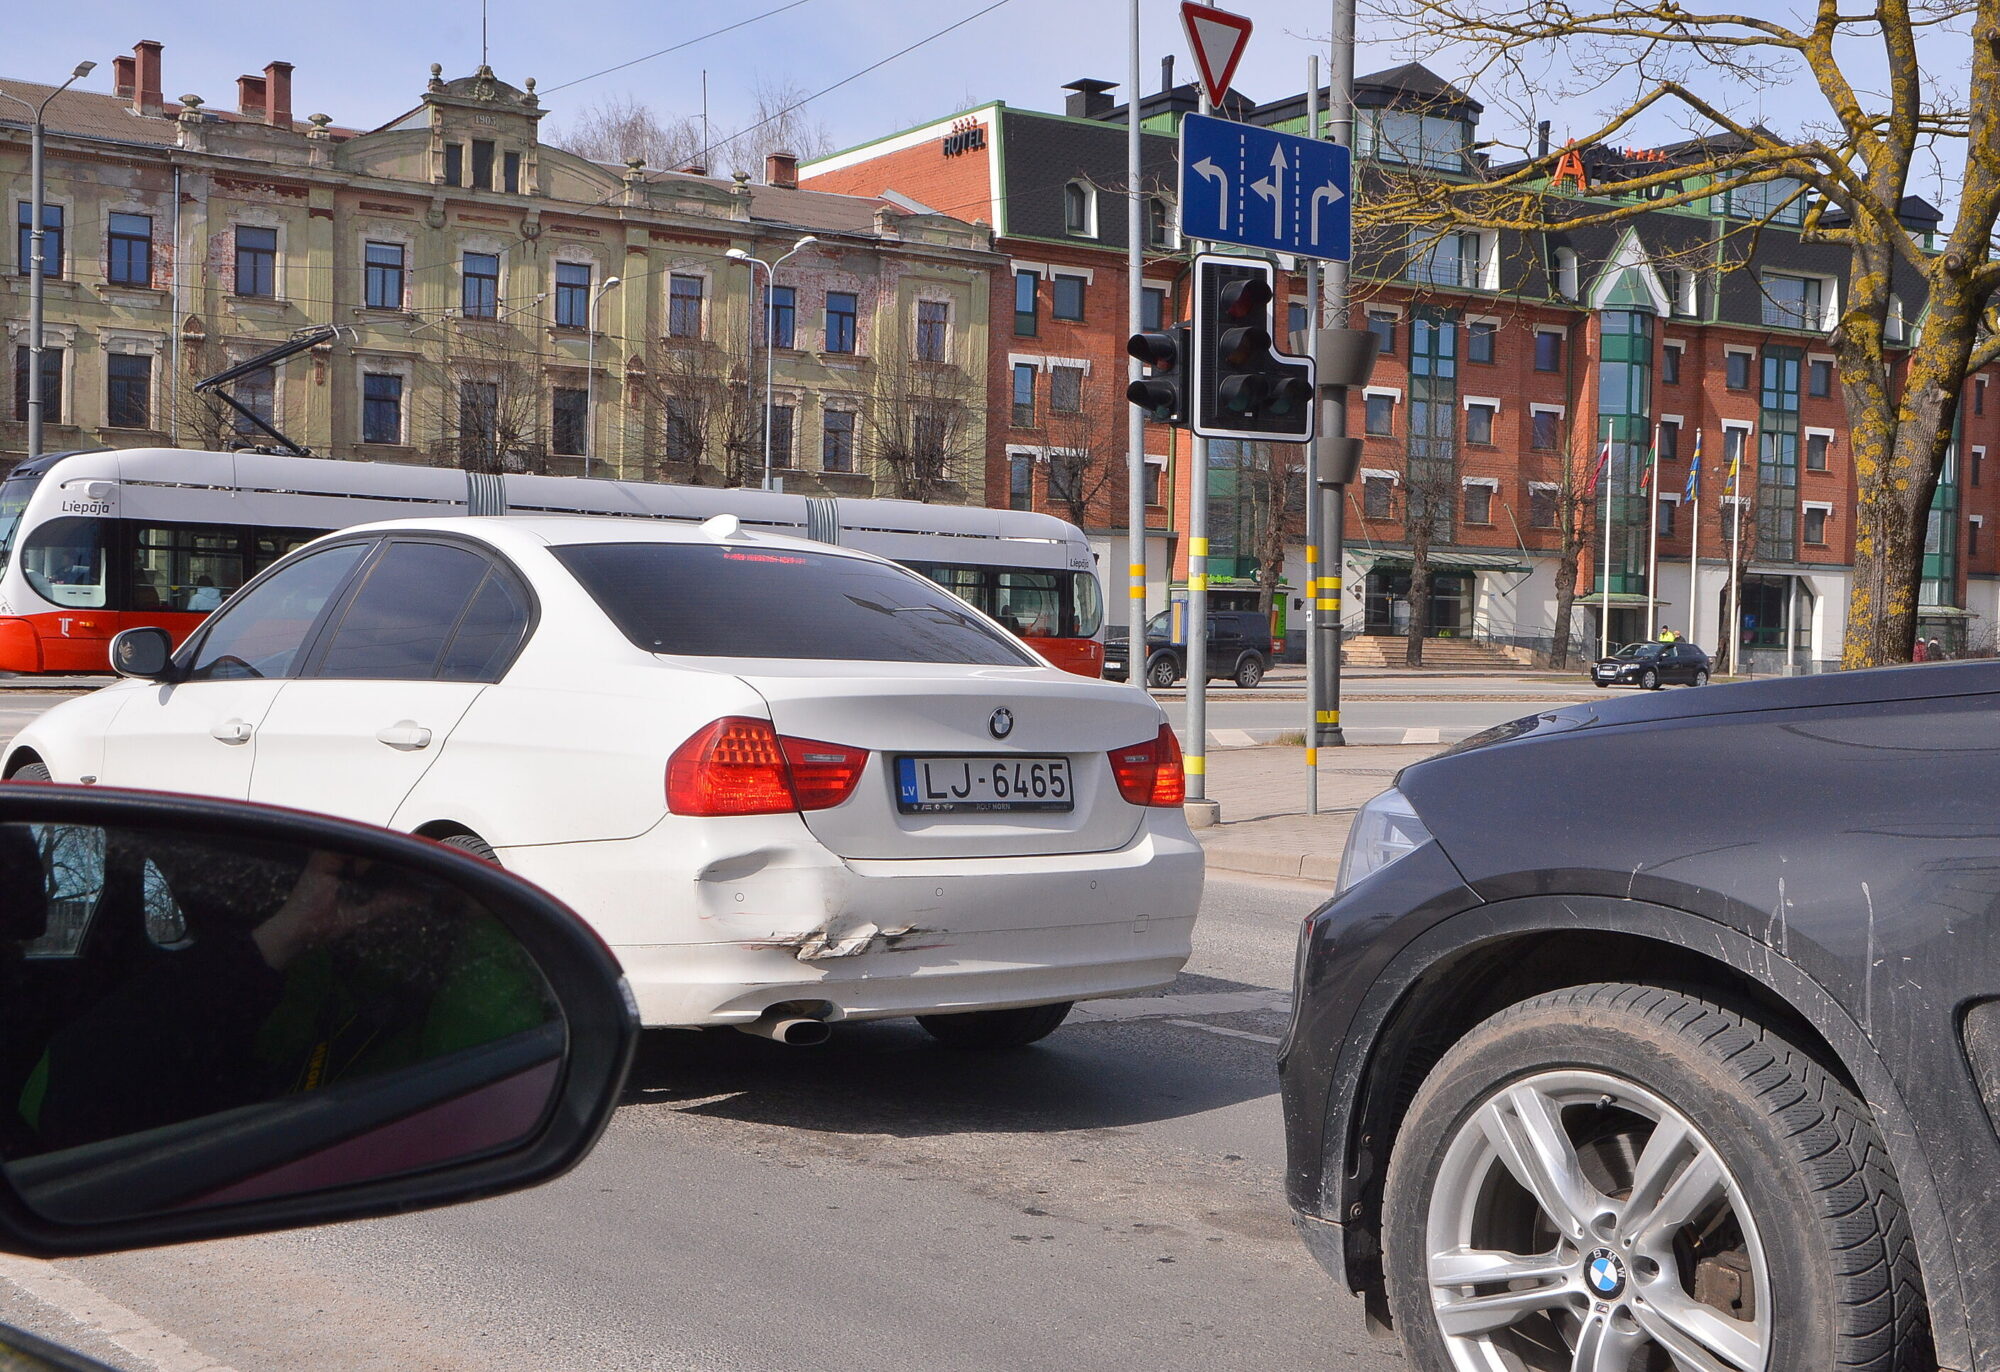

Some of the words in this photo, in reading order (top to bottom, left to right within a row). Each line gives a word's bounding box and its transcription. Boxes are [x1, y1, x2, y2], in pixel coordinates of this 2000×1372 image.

[944, 128, 983, 156] HOTEL
[62, 500, 110, 515] Liepāja
[902, 785, 915, 797] LV
[923, 762, 1066, 799] LJ-6465
[1593, 1248, 1626, 1278] BMW
